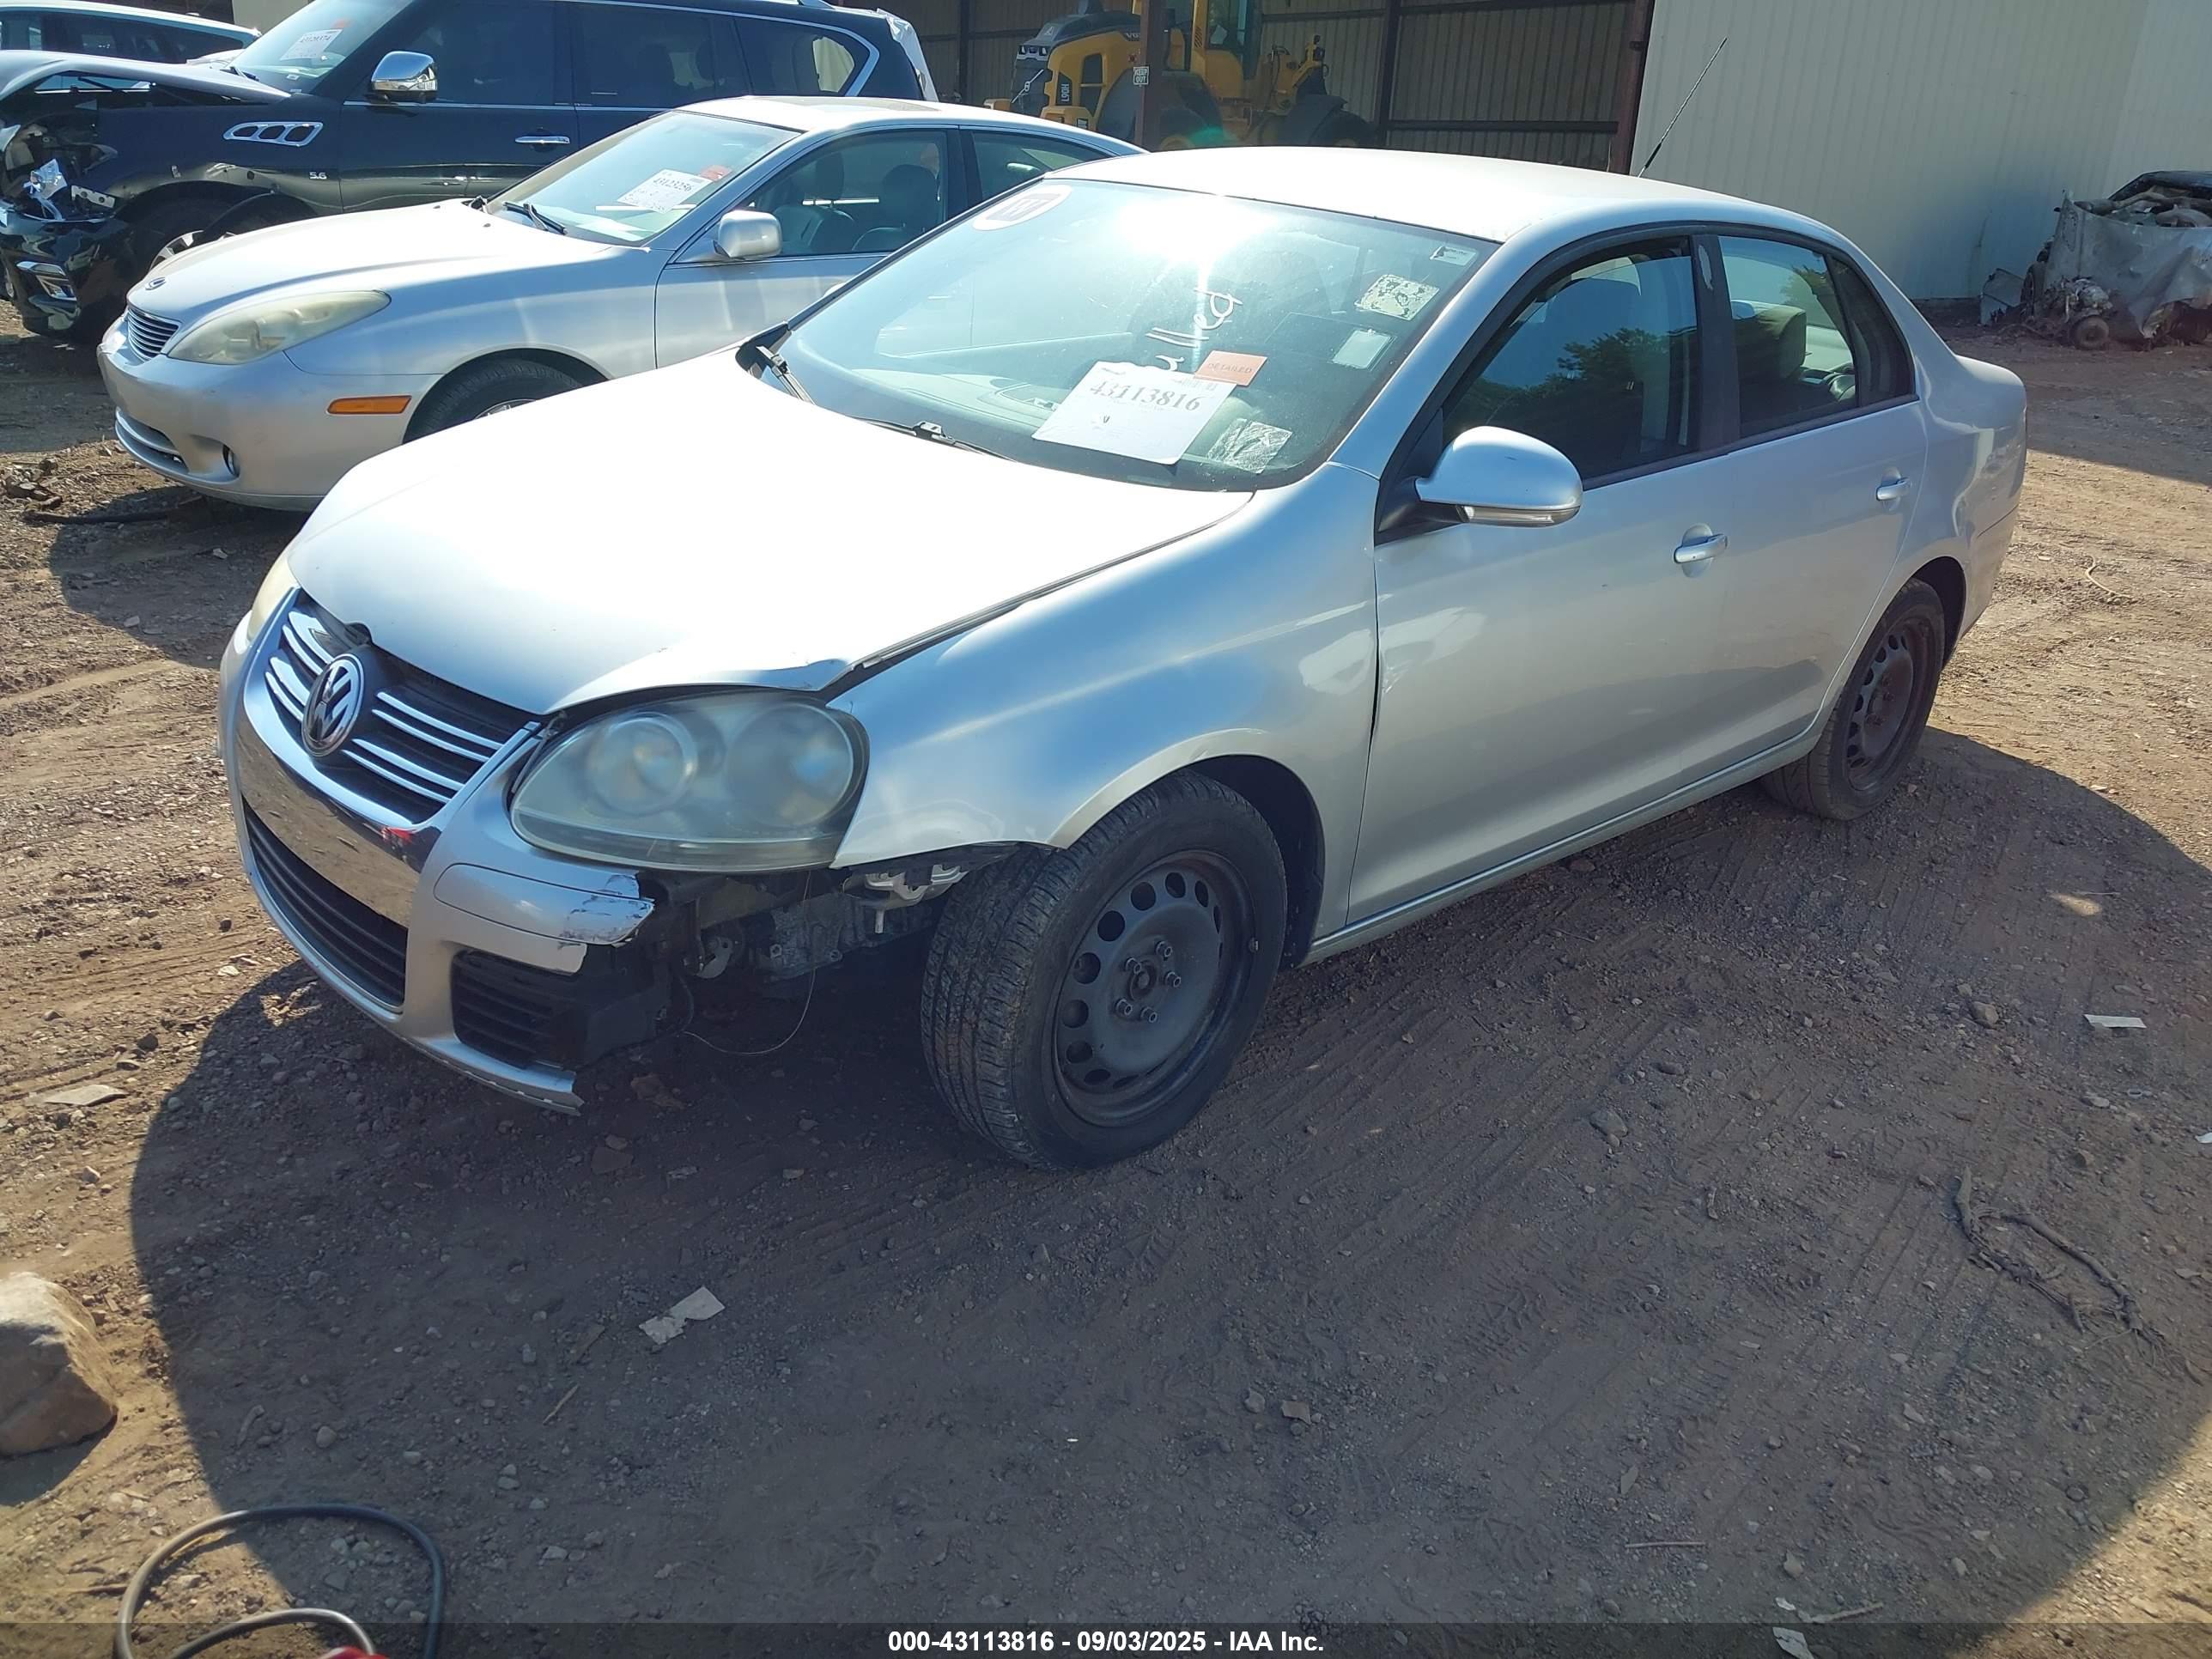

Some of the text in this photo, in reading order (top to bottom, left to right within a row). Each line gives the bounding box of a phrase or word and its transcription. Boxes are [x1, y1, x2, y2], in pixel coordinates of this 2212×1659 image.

[1061, 83, 1070, 102] L90H
[309, 171, 327, 179] 5.6
[1090, 380, 1203, 412] 43113816
